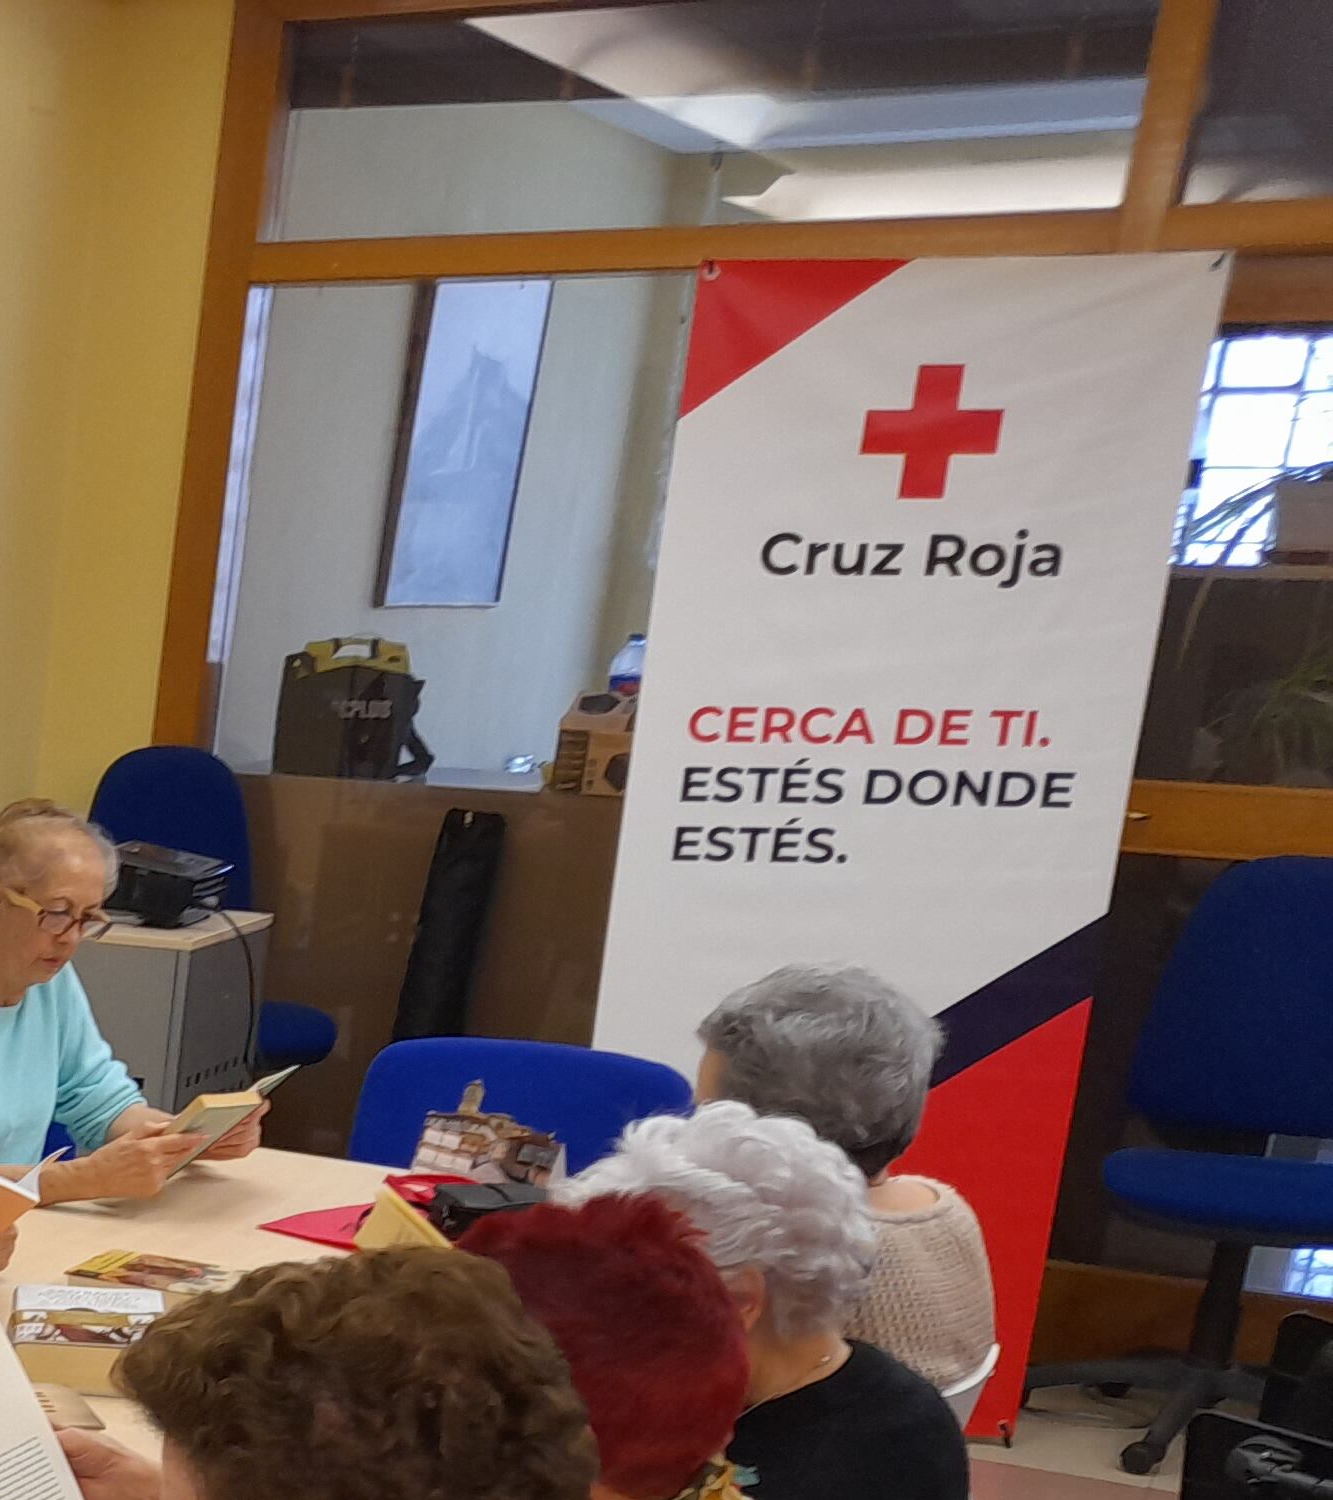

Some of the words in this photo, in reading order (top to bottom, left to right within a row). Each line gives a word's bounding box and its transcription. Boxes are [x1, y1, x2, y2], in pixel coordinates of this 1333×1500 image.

[760, 531, 904, 579] Cruz
[924, 529, 1064, 589] Roja
[687, 705, 875, 746] CERCA
[893, 708, 973, 747] DE
[989, 709, 1052, 749] TI.
[679, 758, 844, 804] ESTÉS
[862, 768, 1079, 809] DONDE
[670, 819, 850, 865] ESTÉS.
